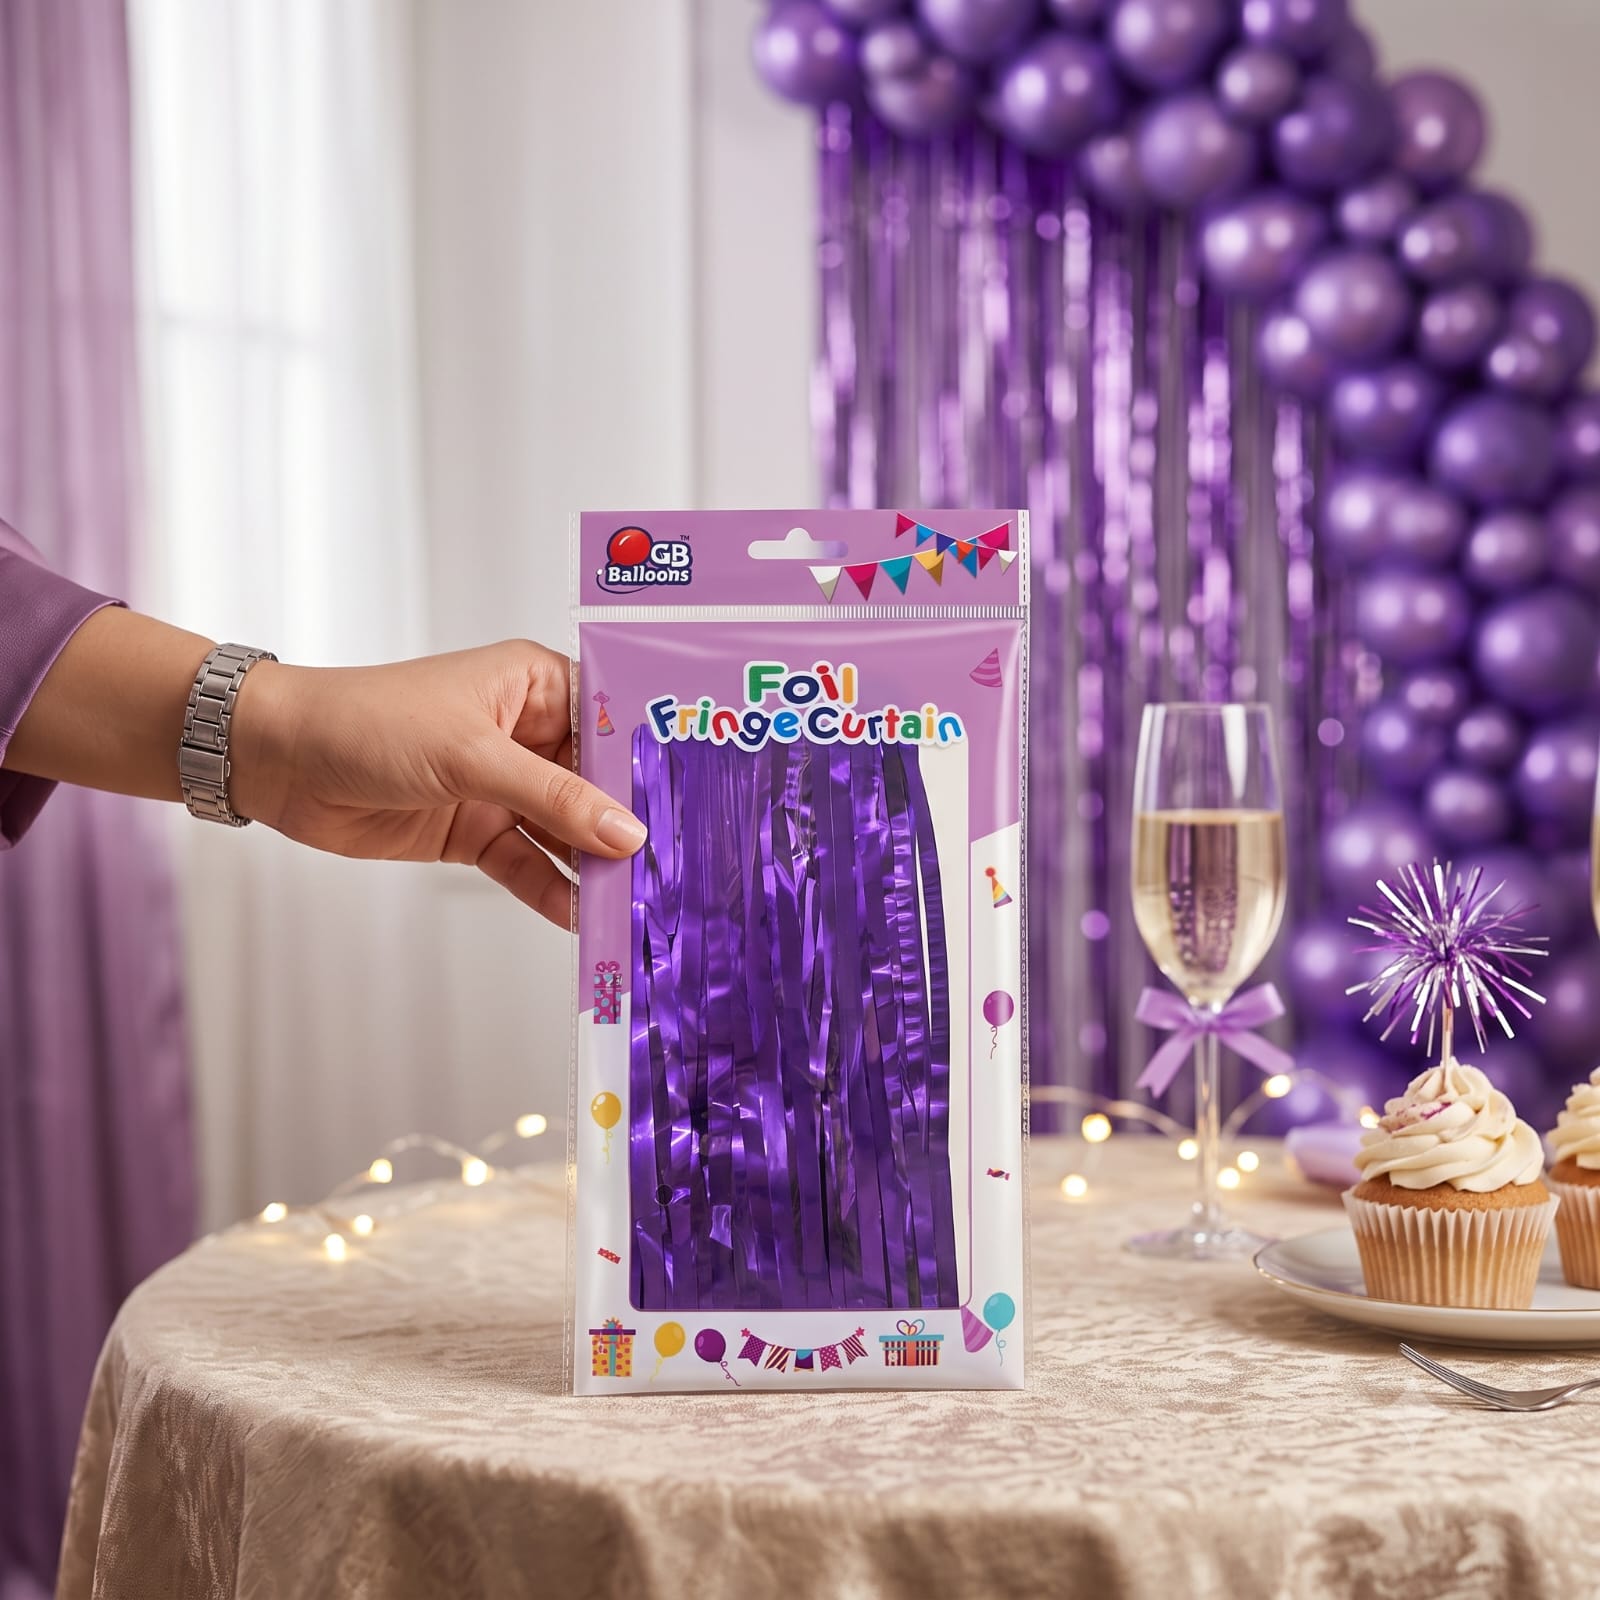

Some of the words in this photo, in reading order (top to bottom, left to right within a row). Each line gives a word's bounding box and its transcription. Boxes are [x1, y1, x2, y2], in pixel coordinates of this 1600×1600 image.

[650, 543, 690, 568] GB
[607, 565, 689, 582] Balloons
[747, 664, 855, 705] Foil
[650, 698, 799, 746] Fringe
[807, 705, 962, 742] Curtain
